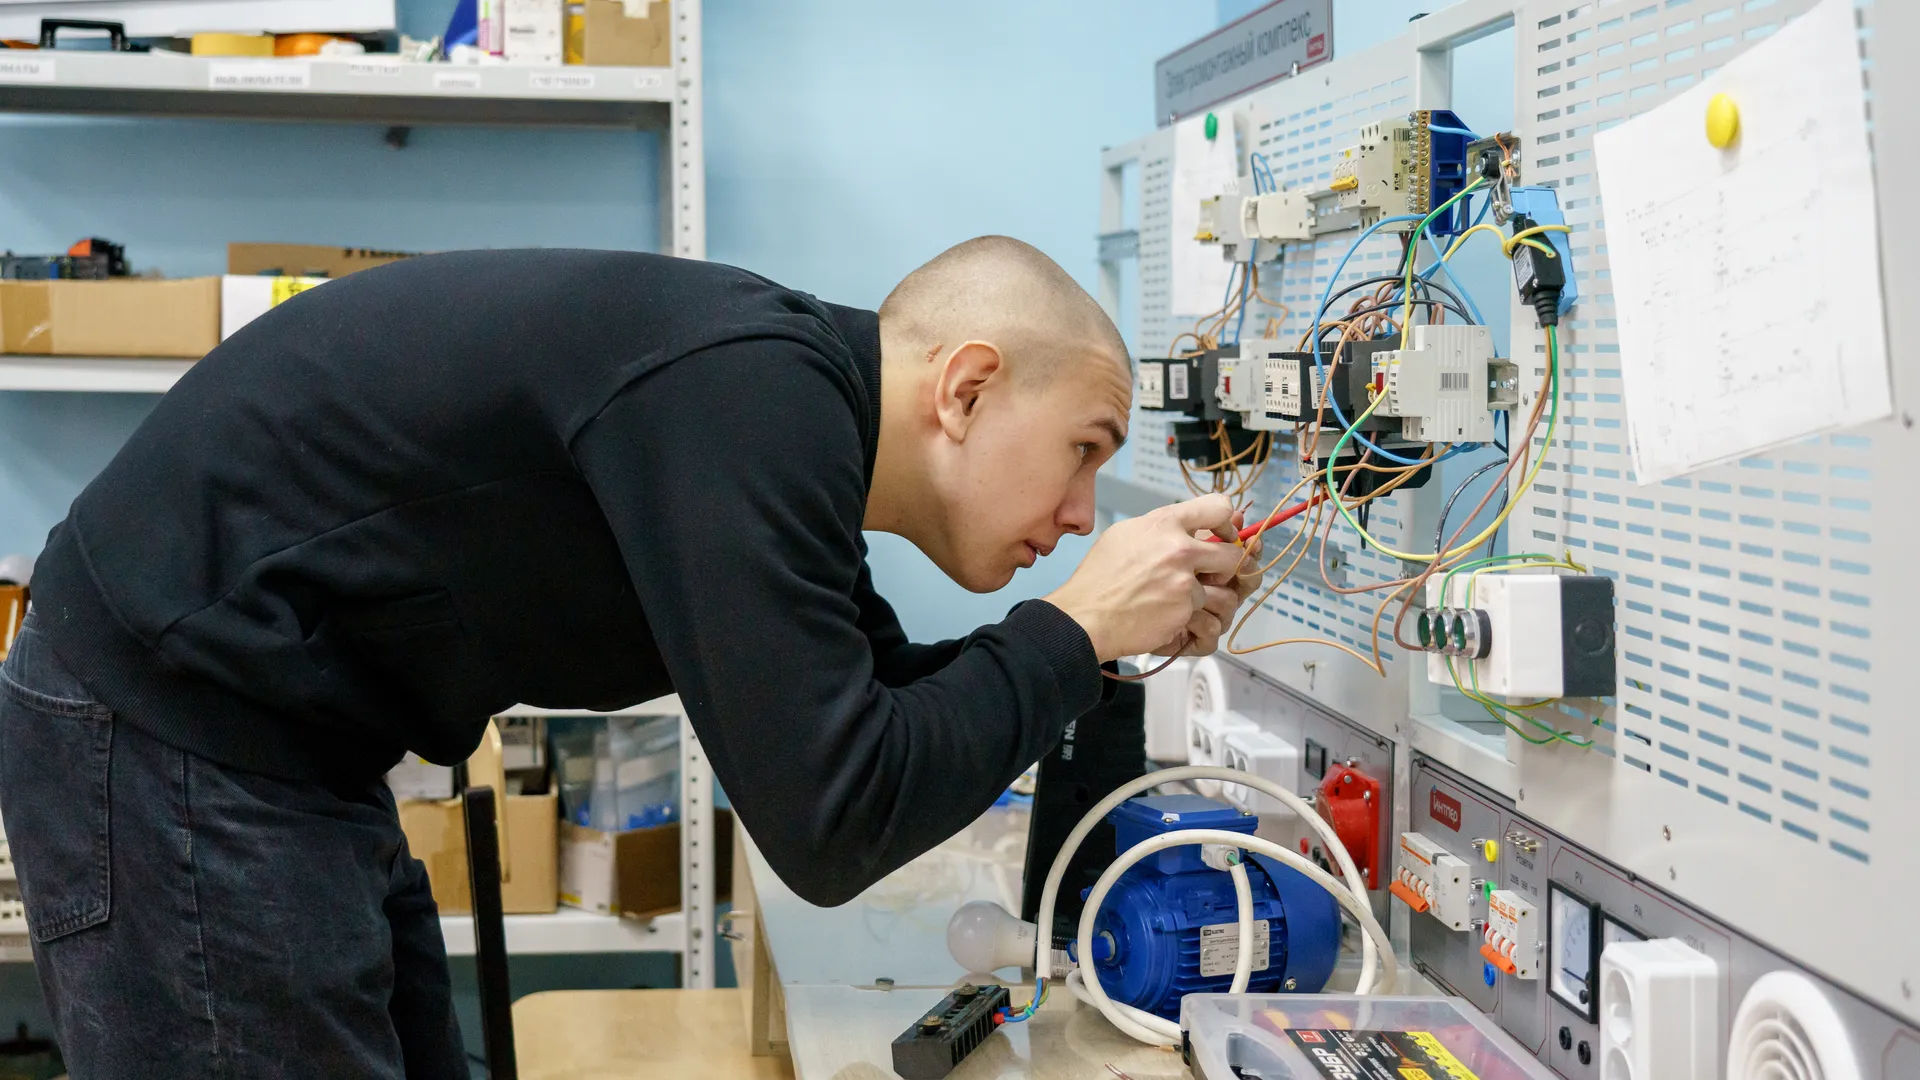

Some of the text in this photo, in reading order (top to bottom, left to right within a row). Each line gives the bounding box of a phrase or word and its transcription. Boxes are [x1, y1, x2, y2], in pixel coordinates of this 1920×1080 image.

[1165, 11, 1311, 99] Электромонтажный комплекс
[1311, 1048, 1357, 1080] ЗУБР
